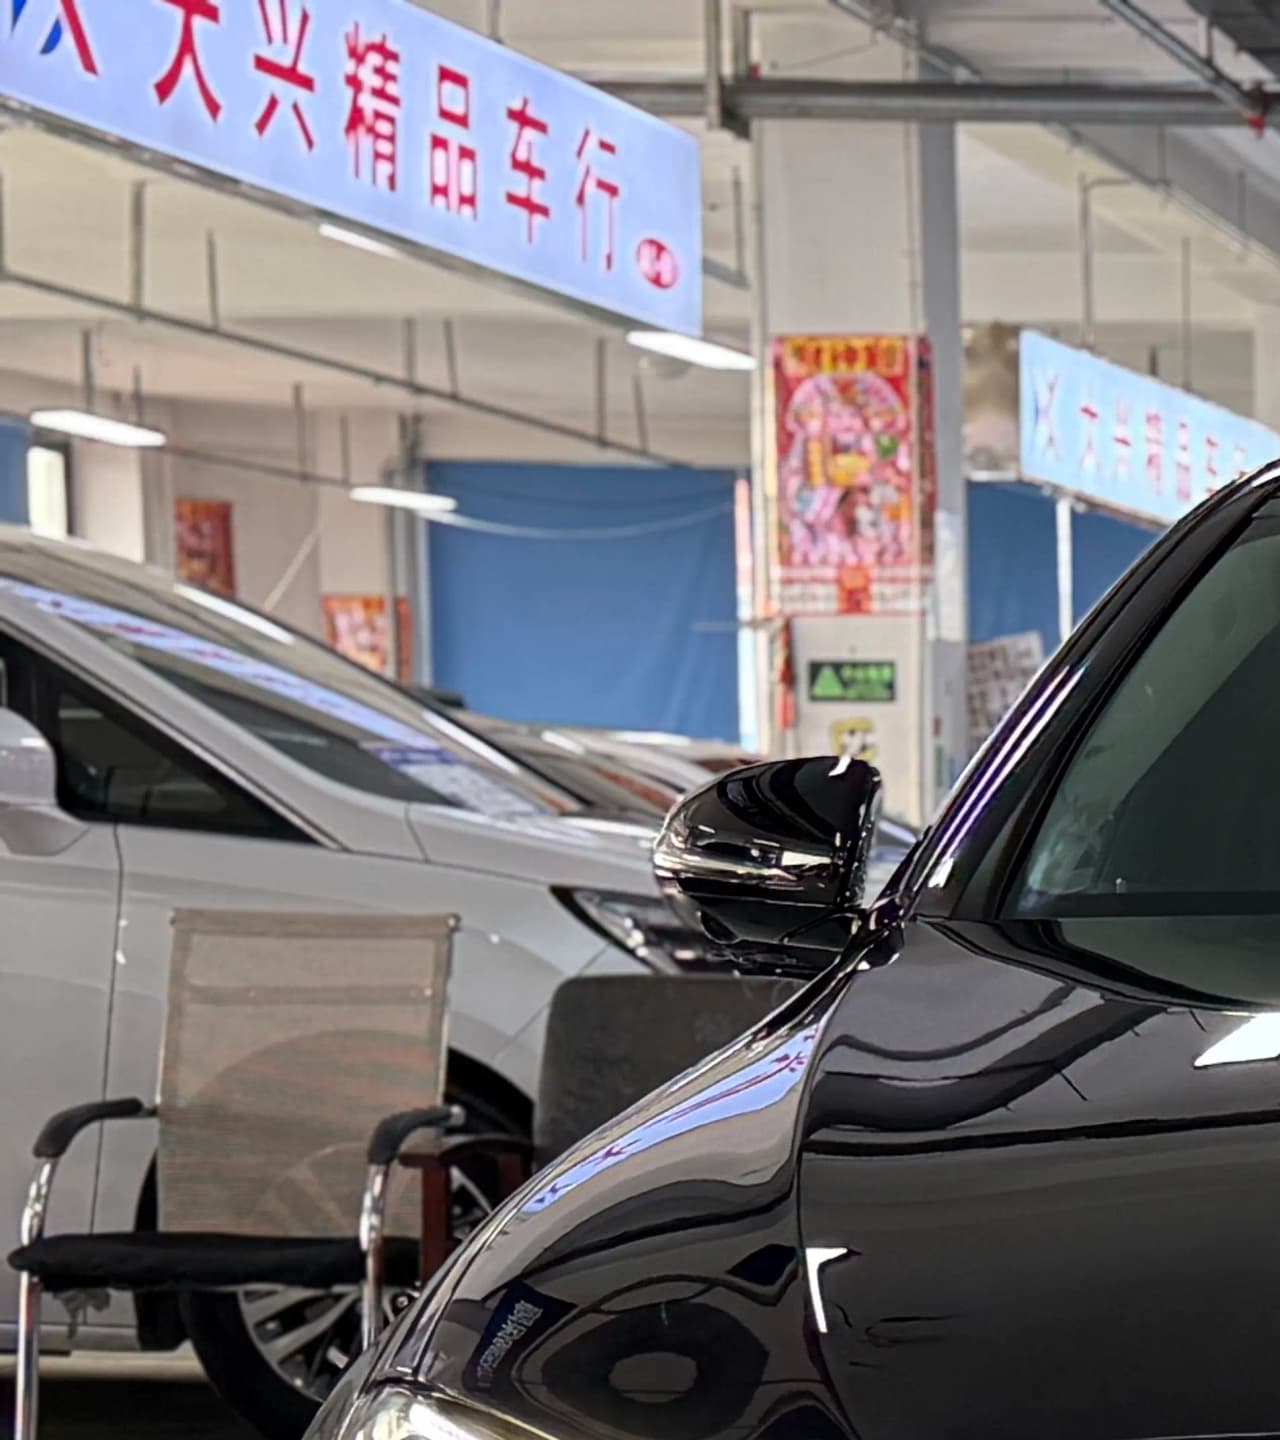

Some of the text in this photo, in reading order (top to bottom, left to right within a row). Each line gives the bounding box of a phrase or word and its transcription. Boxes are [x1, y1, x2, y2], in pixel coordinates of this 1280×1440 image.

[154, 0, 619, 271] 大兴精品车行
